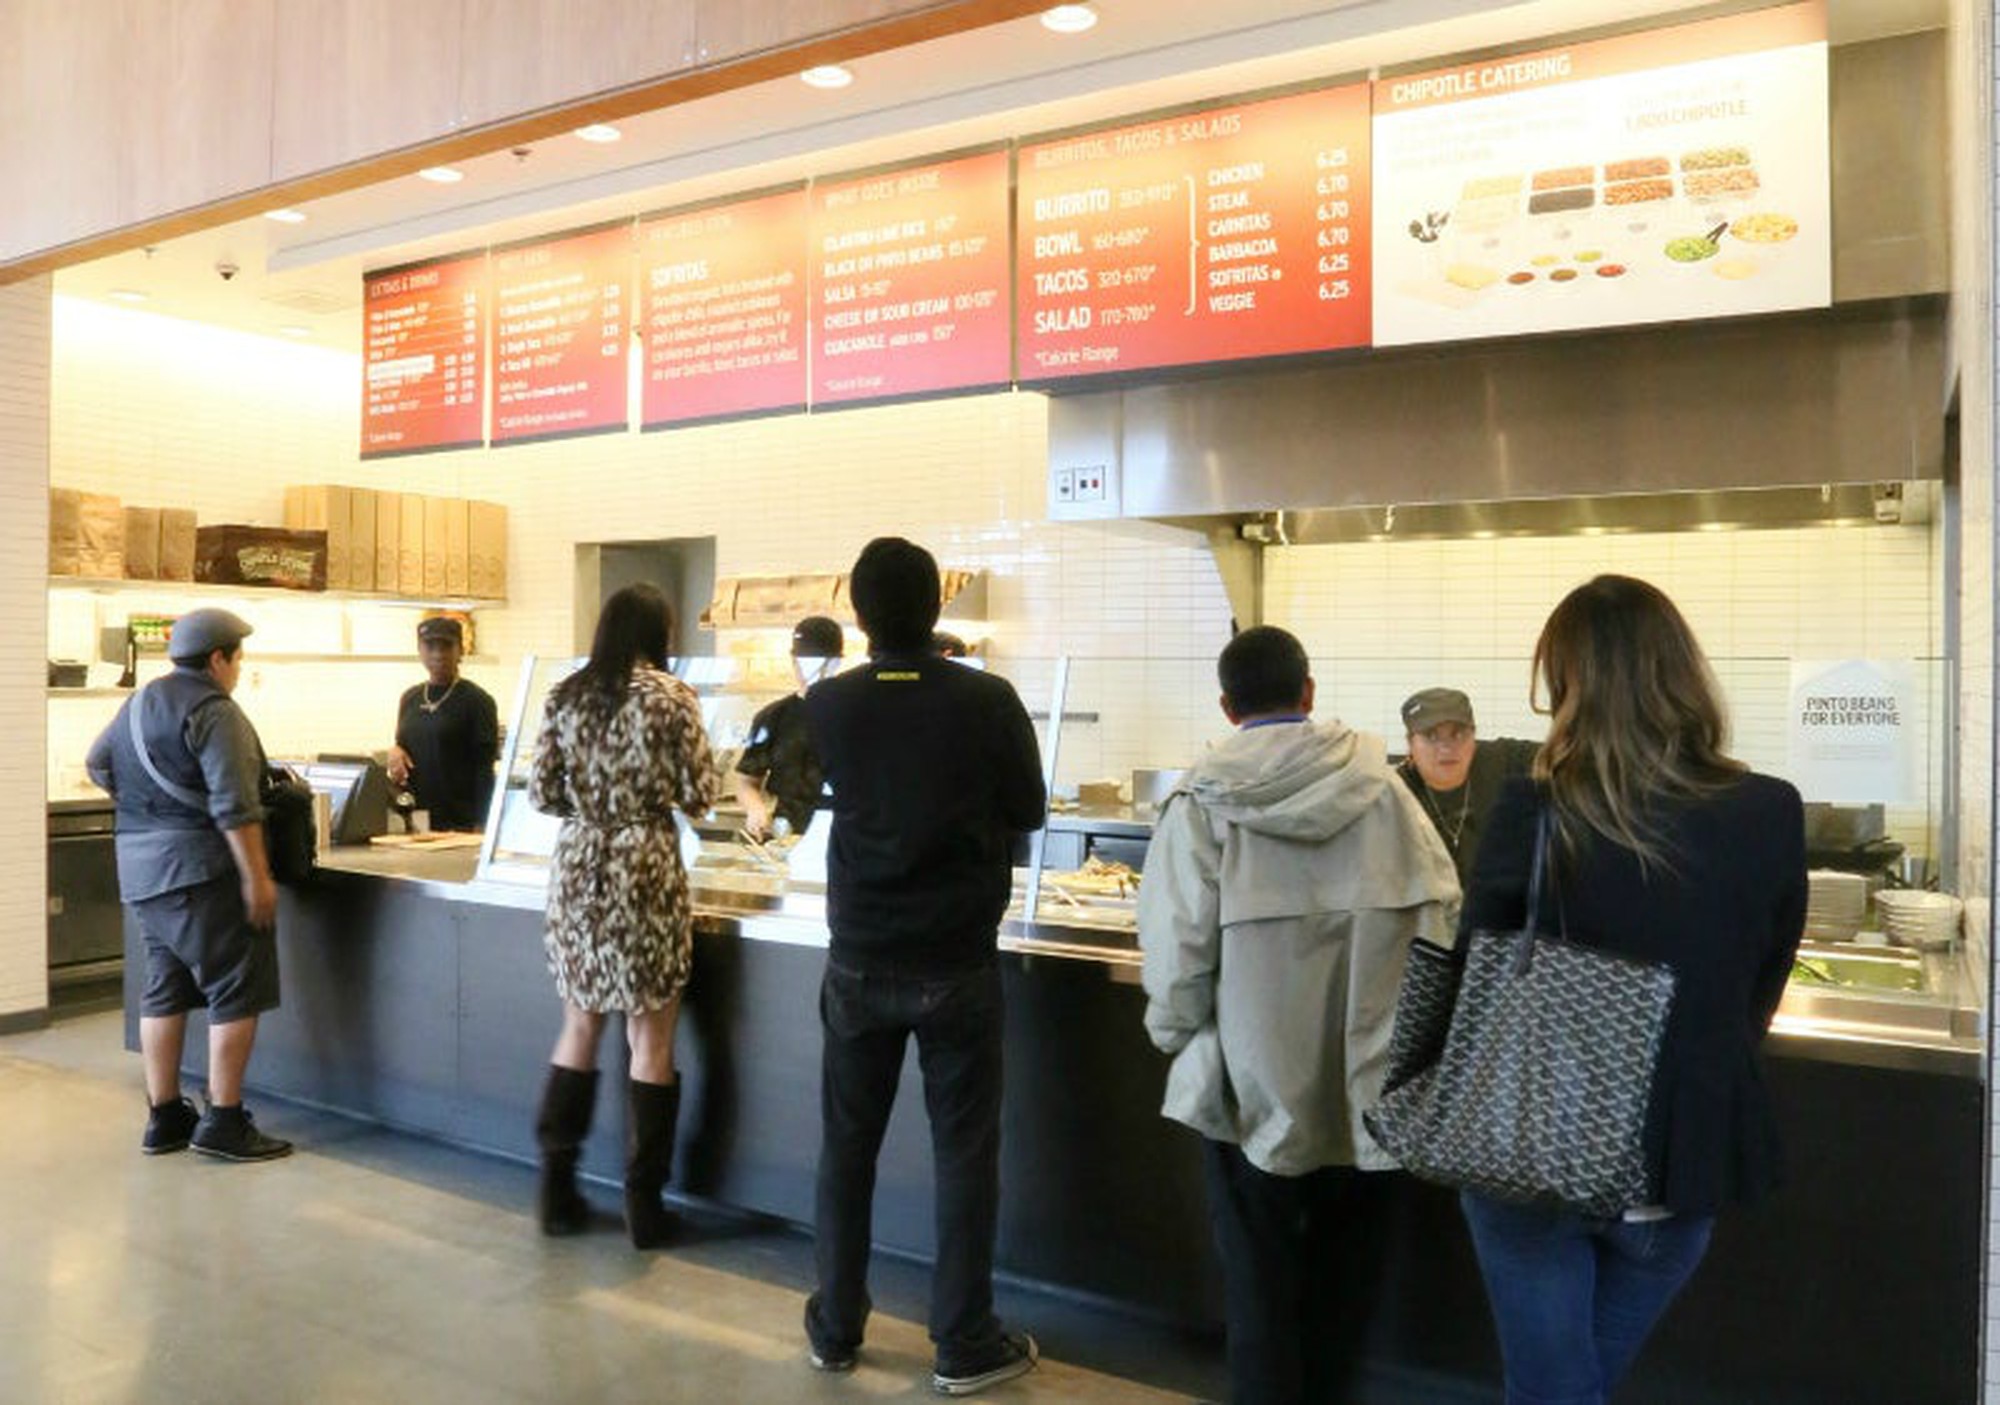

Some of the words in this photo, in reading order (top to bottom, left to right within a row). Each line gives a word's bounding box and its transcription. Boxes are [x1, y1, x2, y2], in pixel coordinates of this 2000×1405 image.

[1392, 71, 1477, 104] CHIPOTLE
[1480, 54, 1571, 88] CATERING
[1115, 130, 1161, 154] TACOS
[1165, 126, 1176, 146] &
[1181, 114, 1241, 142] SALADS
[1208, 163, 1264, 187] CHICKEN
[1034, 188, 1110, 221] BURRITO
[1208, 191, 1249, 212] STEAK
[1316, 174, 1348, 195] 6.70
[902, 220, 926, 237] RICE
[1208, 212, 1272, 237] CARNITAS
[1317, 201, 1348, 221] 6.70
[1034, 231, 1083, 259] BOWL
[1208, 238, 1278, 262] BARBACOA
[1317, 226, 1349, 248] 6.70
[651, 260, 708, 289] SOFRITAS
[824, 259, 856, 278] BLACK
[858, 256, 874, 272] OR
[875, 250, 906, 269] PINTO
[908, 244, 944, 264] BEANS
[1209, 265, 1269, 288] SOFRITAS
[1318, 253, 1349, 274] 6.25
[824, 284, 856, 304] SALSA
[1034, 268, 1089, 296] TACOS
[1209, 291, 1256, 313] VEGGIE
[1319, 279, 1350, 300] 6.25
[824, 311, 861, 330] CHEESE
[864, 308, 879, 324] OR
[881, 302, 910, 321] SOUR
[912, 298, 949, 316] CREAM
[1034, 306, 1091, 334] SALAD
[824, 333, 886, 356] GUACAMOLE
[1081, 346, 1119, 361] Range
[1807, 697, 1848, 711] PINTO
[1850, 697, 1896, 711] BEANS
[1802, 712, 1830, 726] FOR
[1831, 712, 1901, 726] EVERYONE
